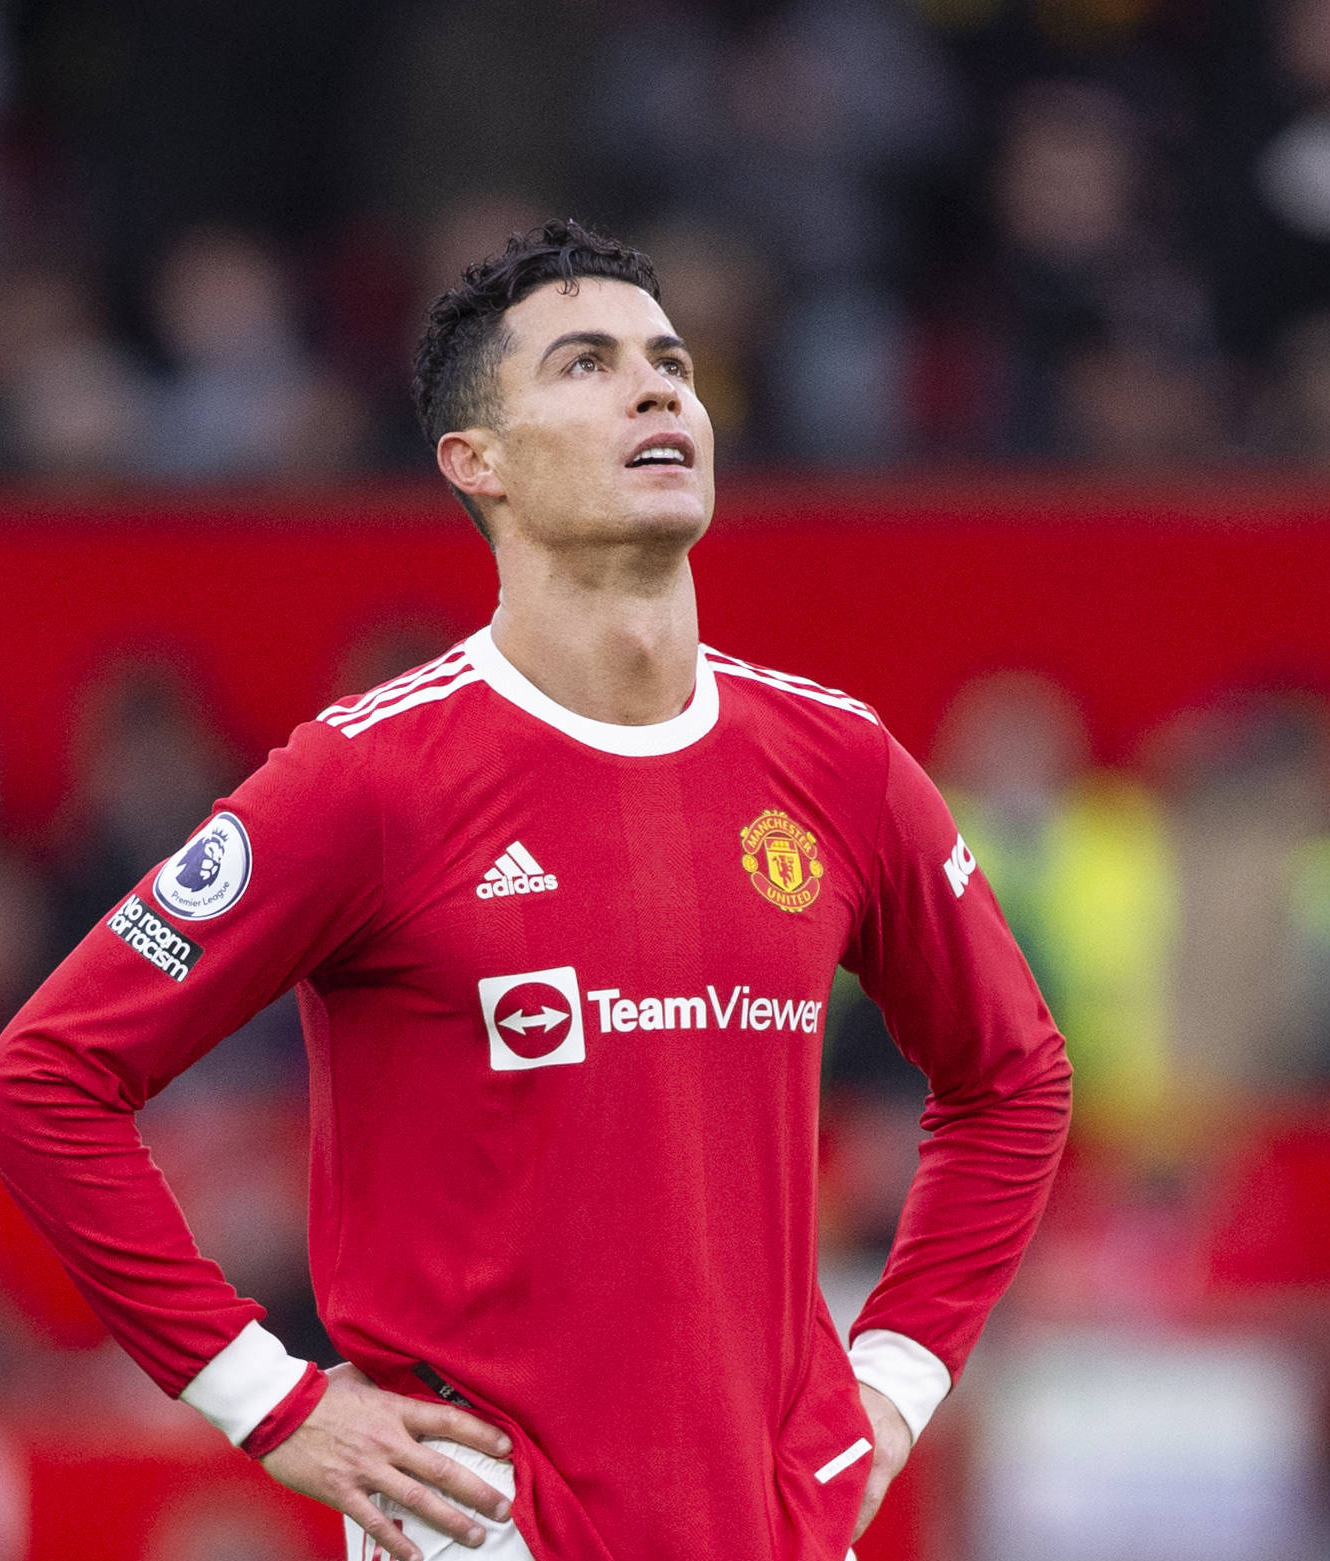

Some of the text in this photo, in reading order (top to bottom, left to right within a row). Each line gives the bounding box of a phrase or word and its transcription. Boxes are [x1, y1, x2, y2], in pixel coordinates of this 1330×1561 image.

[747, 818, 812, 853] MANCHESTER
[171, 881, 230, 907] Premier League
[476, 873, 558, 900] adidas
[767, 887, 811, 905] UNITED
[121, 894, 191, 961] No room
[107, 910, 189, 983] for racism
[587, 985, 822, 1034] TeamViewer
